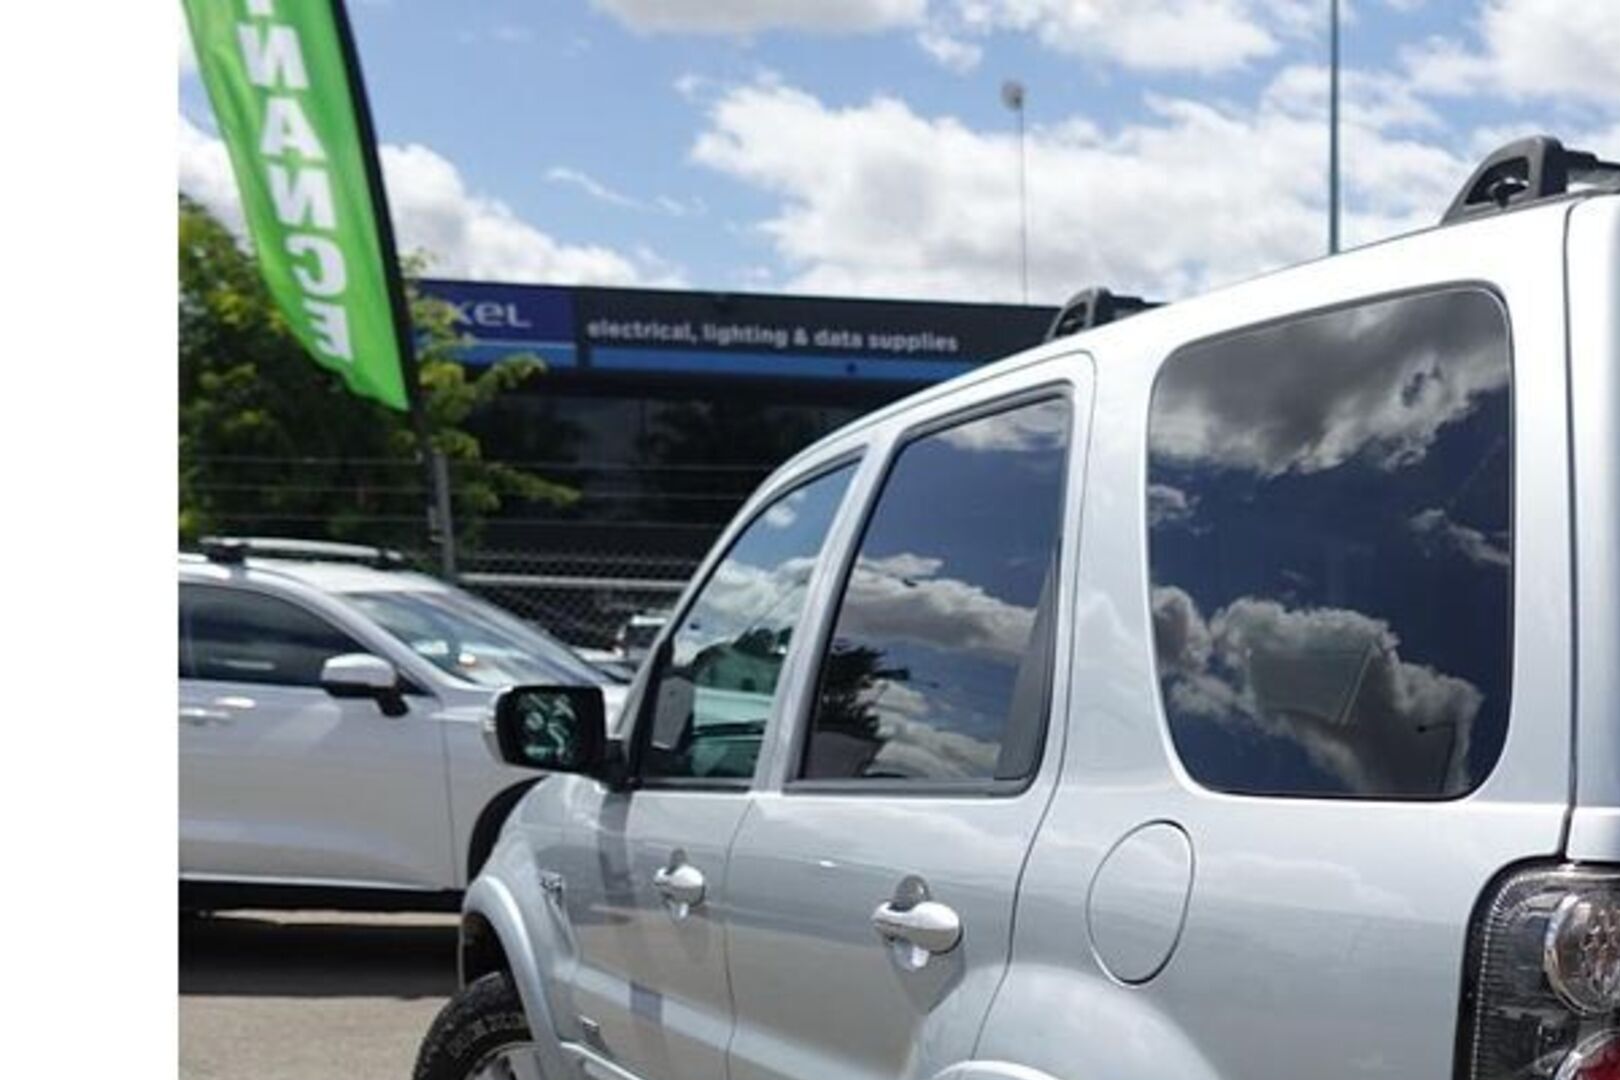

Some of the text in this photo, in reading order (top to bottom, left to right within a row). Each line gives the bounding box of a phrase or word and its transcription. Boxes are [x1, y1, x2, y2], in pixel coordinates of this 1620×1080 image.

[587, 318, 959, 352] electrical, lighting & data supplies
